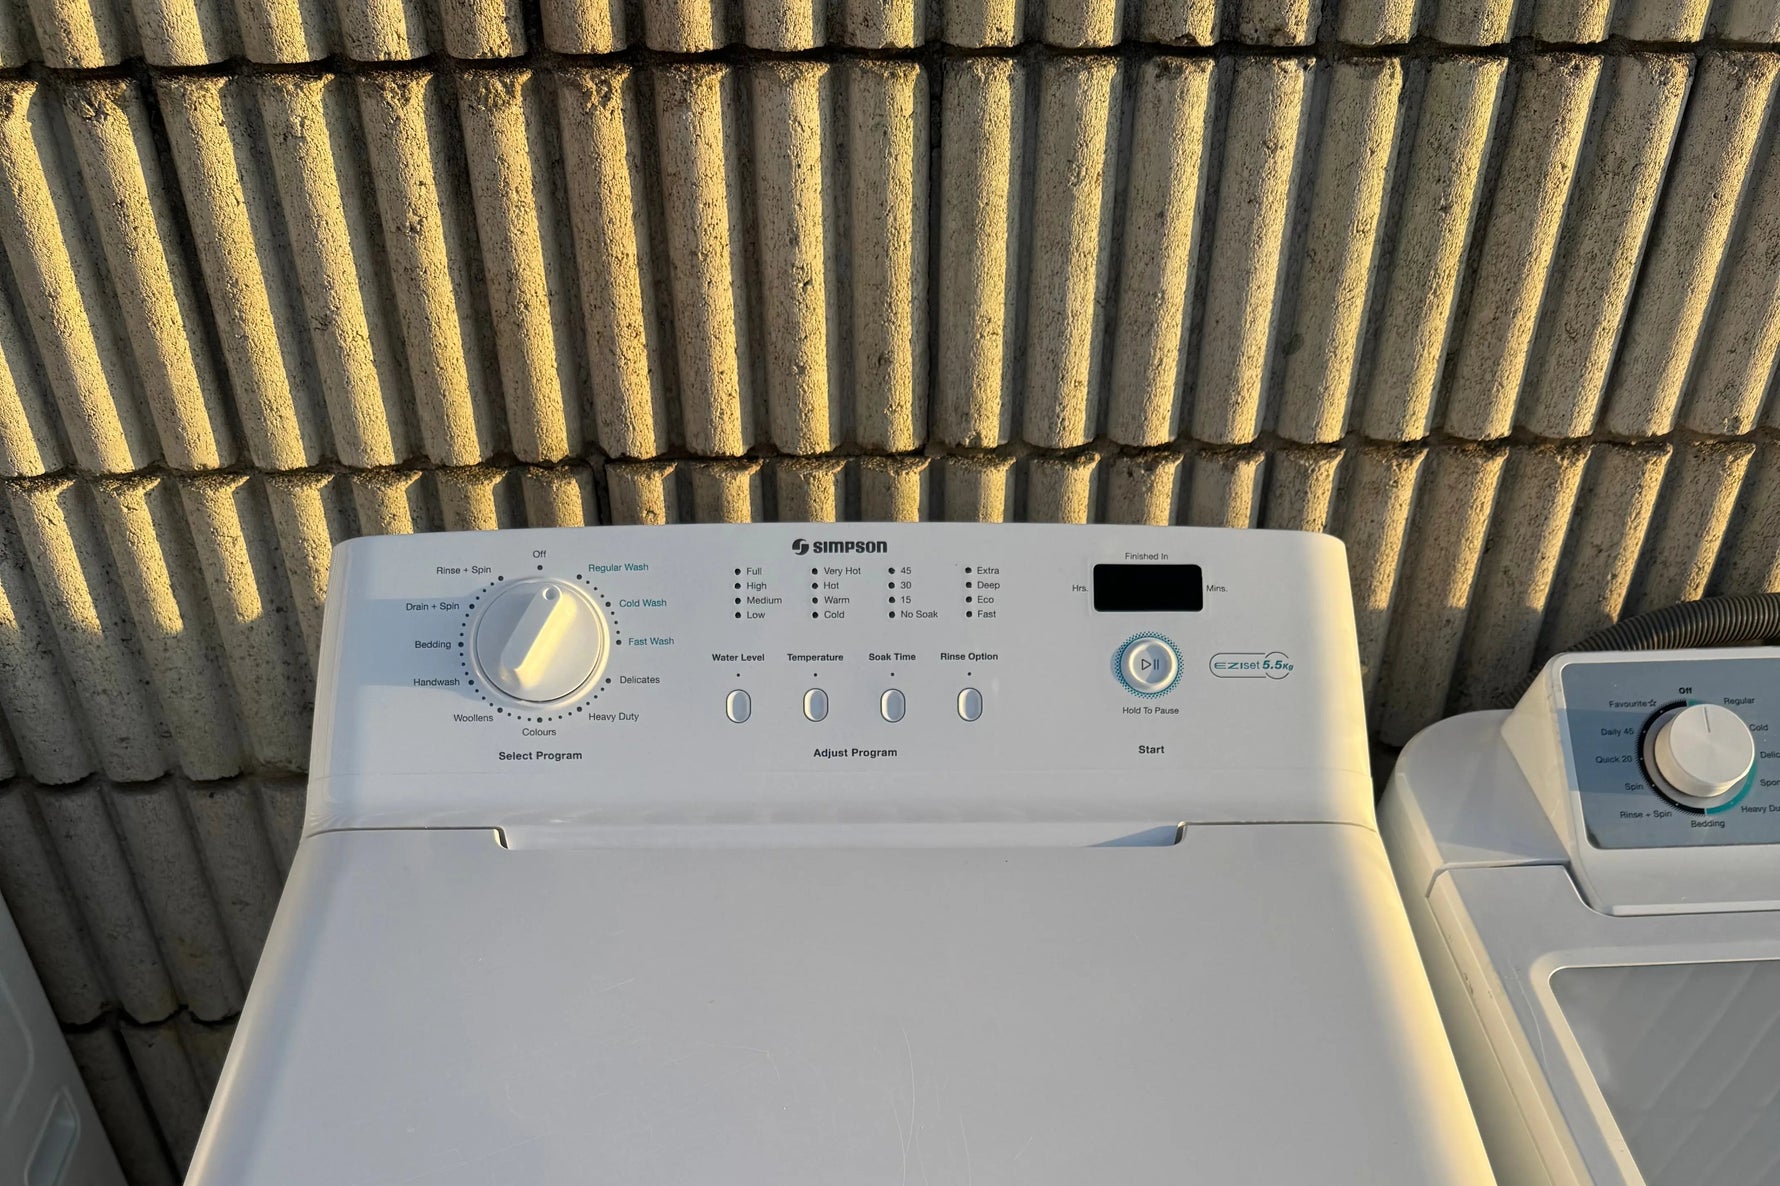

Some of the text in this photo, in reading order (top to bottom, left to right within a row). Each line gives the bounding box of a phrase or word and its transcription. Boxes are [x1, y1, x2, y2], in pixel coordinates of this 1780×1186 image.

[813, 540, 887, 554] SIMPSON
[436, 566, 461, 574] Rinse
[471, 566, 491, 575] Spin
[588, 563, 648, 573] Regular Wash
[746, 567, 762, 575] Full
[824, 567, 861, 576] Very Hot
[746, 582, 767, 591] High
[977, 581, 1000, 591] Deep
[641, 599, 666, 607] Wash
[824, 596, 849, 604] Warm
[901, 596, 911, 604] 15
[977, 596, 994, 604] Eco
[406, 602, 428, 610] Drain
[440, 602, 459, 612] Spin
[746, 611, 765, 619] Low
[824, 611, 844, 619] Cold
[916, 610, 938, 618] Soak
[977, 610, 996, 618] Fast
[415, 640, 451, 650] Bedding
[628, 637, 674, 645] Fast Wash
[787, 654, 843, 663] Temperature
[868, 653, 916, 661] Soak Time
[940, 652, 998, 662] Rinse Option
[413, 678, 460, 686] Handwash
[620, 676, 660, 684] Delicates
[1609, 700, 1647, 708] Favourite
[1724, 697, 1755, 705] Regular
[1123, 707, 1179, 715] Hold To Pause
[454, 714, 493, 722] Woollens
[589, 713, 639, 722] Heavy Duty
[522, 728, 556, 736] Colours
[1601, 728, 1620, 736] Daily
[813, 749, 897, 758] Adjust Program
[1138, 745, 1165, 754] Start
[499, 751, 582, 761] Select Program
[1596, 755, 1633, 764] Quick 20
[1625, 783, 1644, 791] Spin
[1741, 805, 1767, 814] Heavy
[1653, 810, 1672, 818] Spin
[1691, 820, 1725, 828] Bedding
